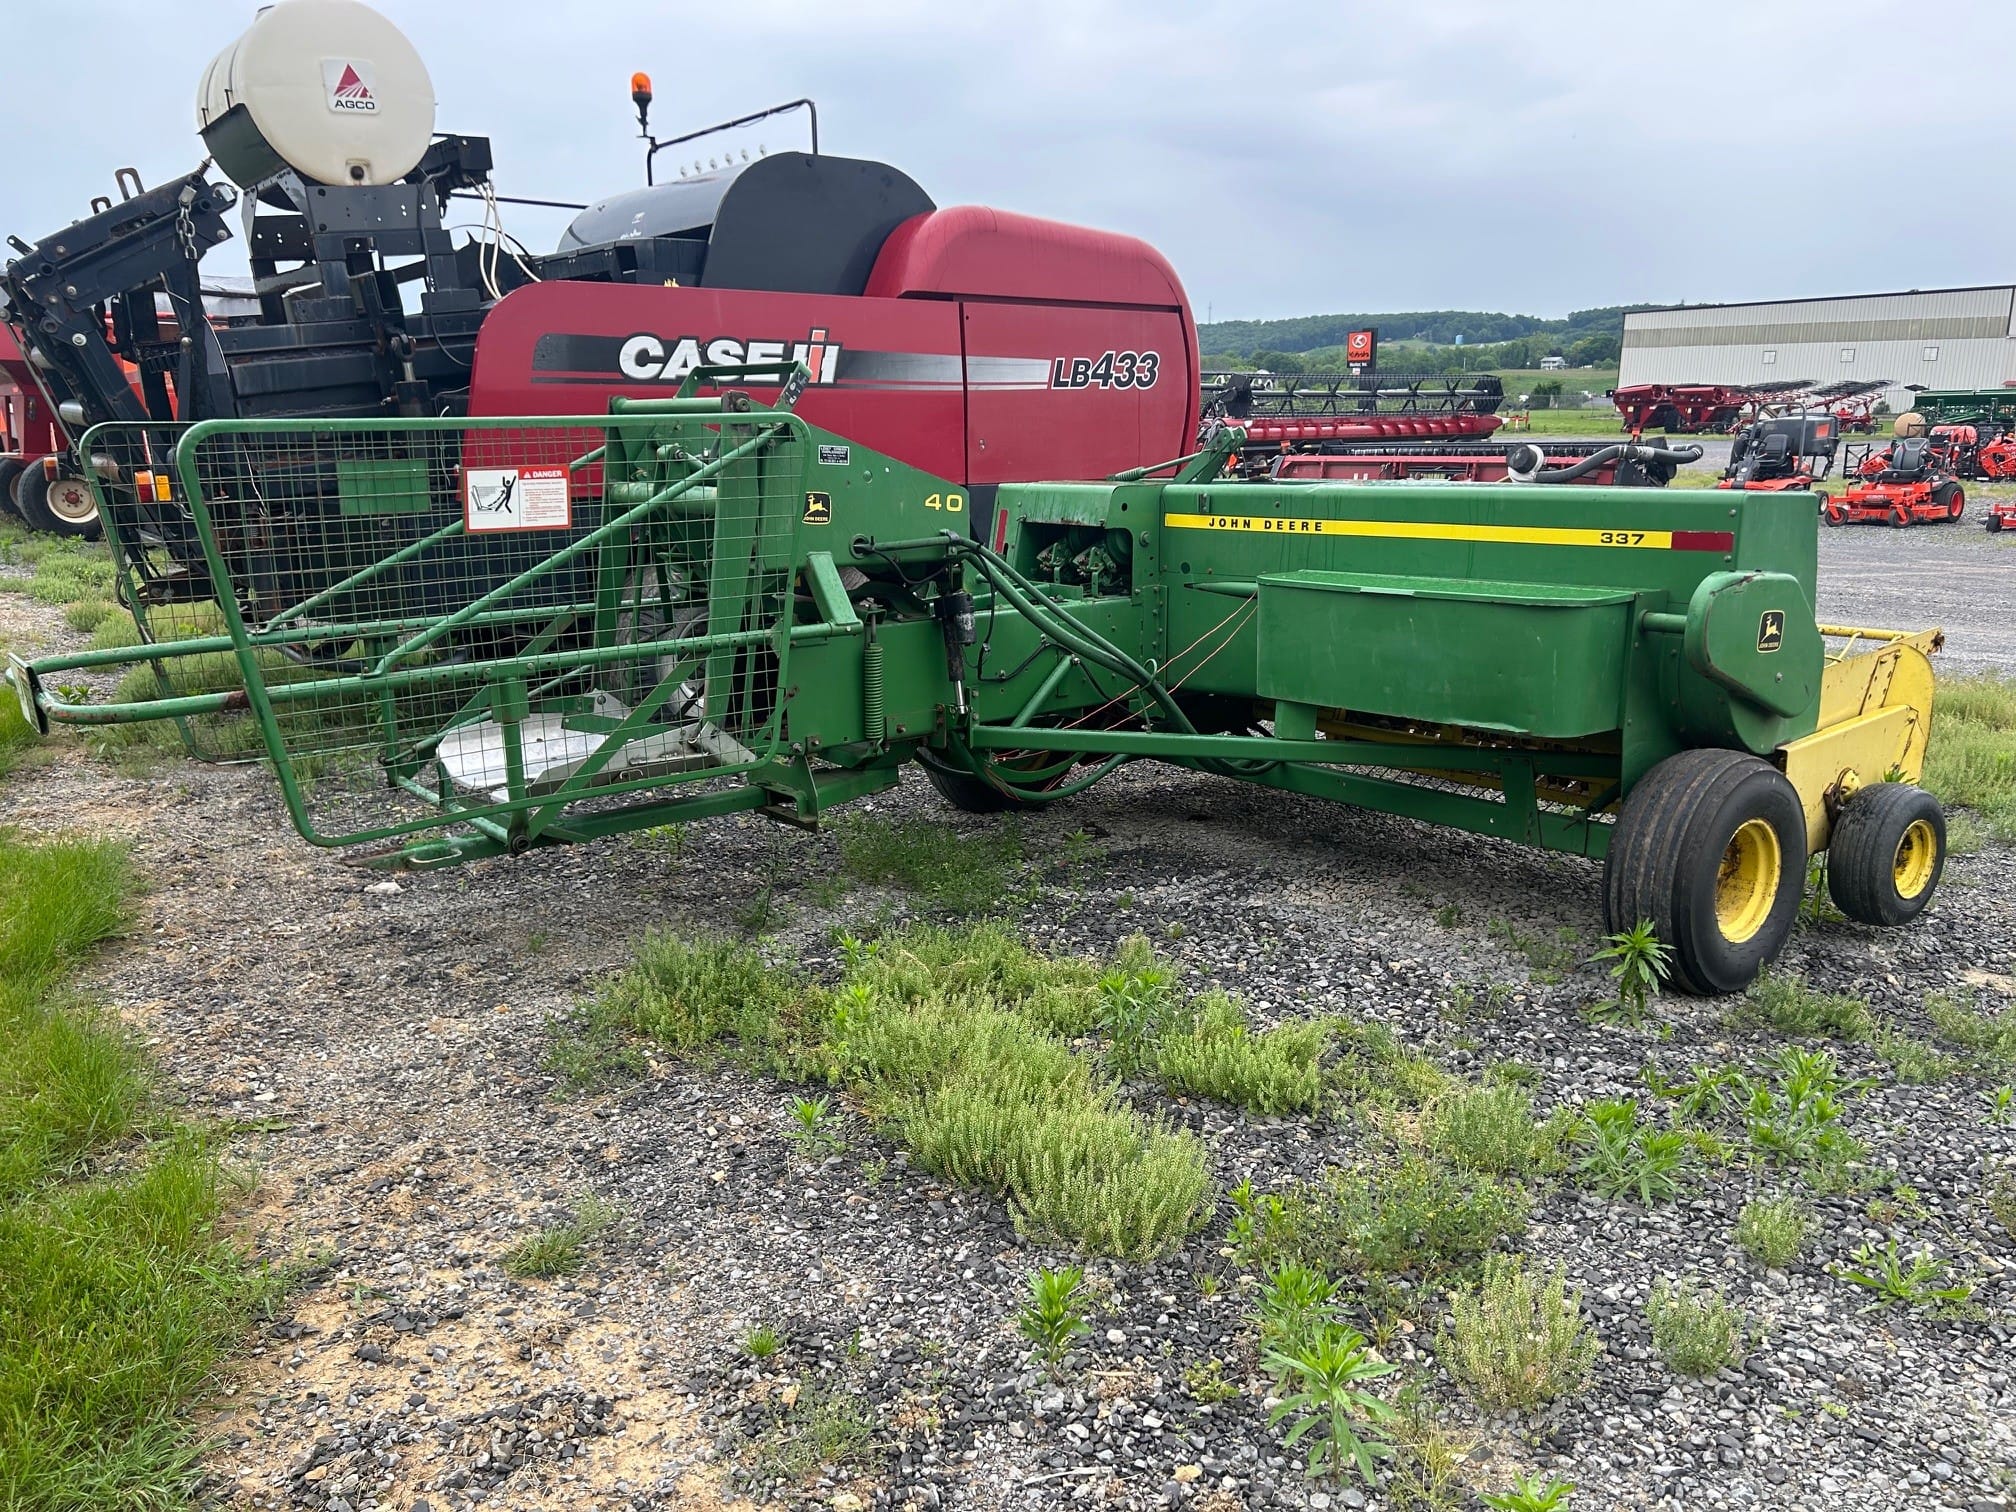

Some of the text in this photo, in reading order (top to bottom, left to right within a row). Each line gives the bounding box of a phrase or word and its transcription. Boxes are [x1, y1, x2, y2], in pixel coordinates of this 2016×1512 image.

[335, 100, 375, 110] AGCO
[619, 336, 785, 382] CASE
[1051, 350, 1160, 390] LB433
[532, 470, 562, 479] DANGER
[925, 493, 963, 511] 40
[1208, 517, 1322, 532] JOHN DEERE
[1600, 532, 1645, 545] 337
